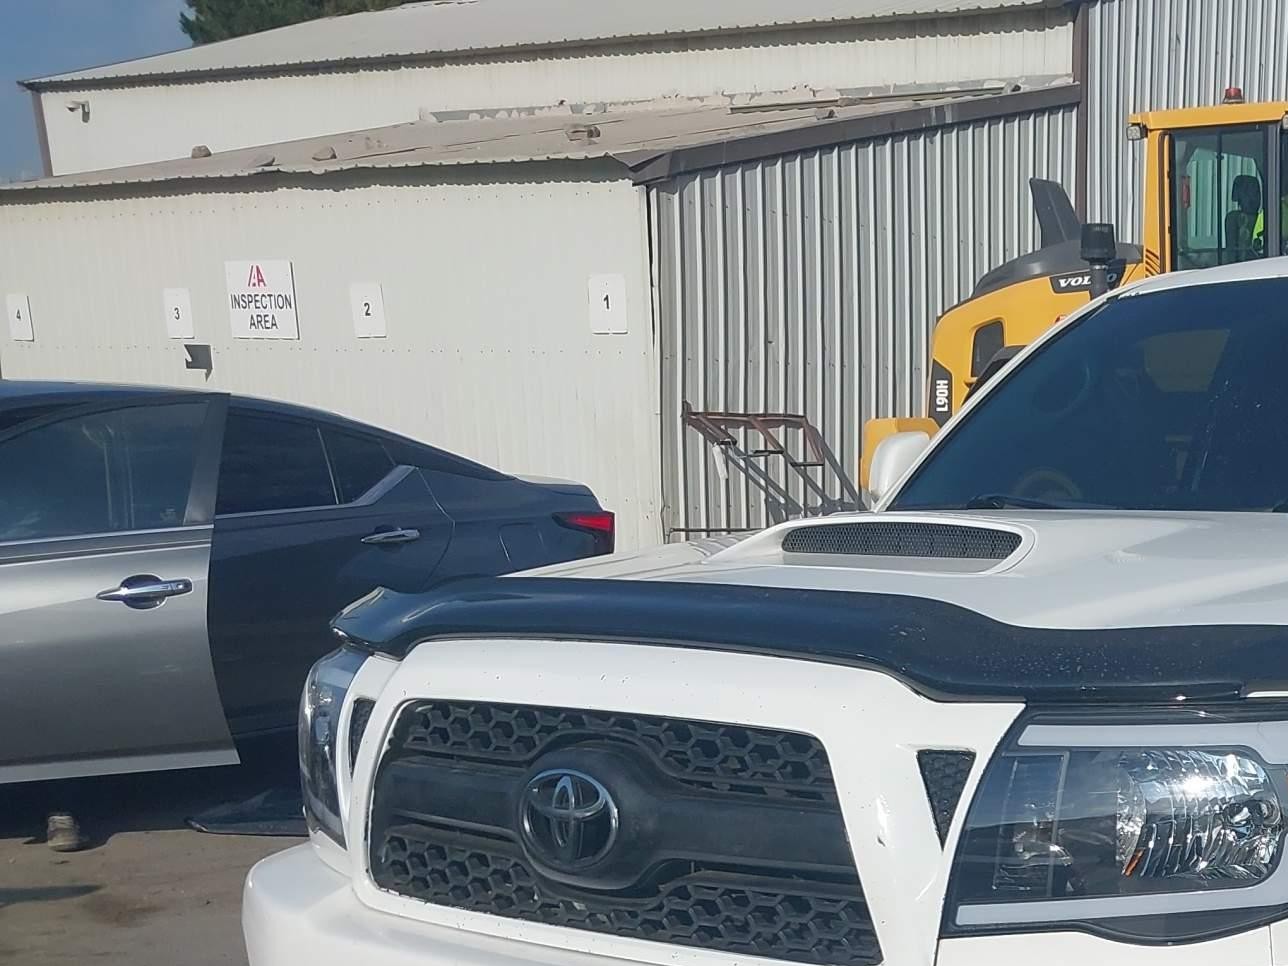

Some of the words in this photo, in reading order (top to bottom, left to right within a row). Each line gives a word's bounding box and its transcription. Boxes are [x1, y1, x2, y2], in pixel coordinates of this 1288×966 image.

[1059, 273, 1117, 288] VOLO
[230, 294, 292, 310] INSPECTION
[363, 302, 371, 317] 2
[603, 294, 610, 310] 1
[16, 309, 21, 321] 4
[174, 307, 180, 320] 3
[249, 314, 279, 330] AREA
[935, 380, 948, 412] L90H
